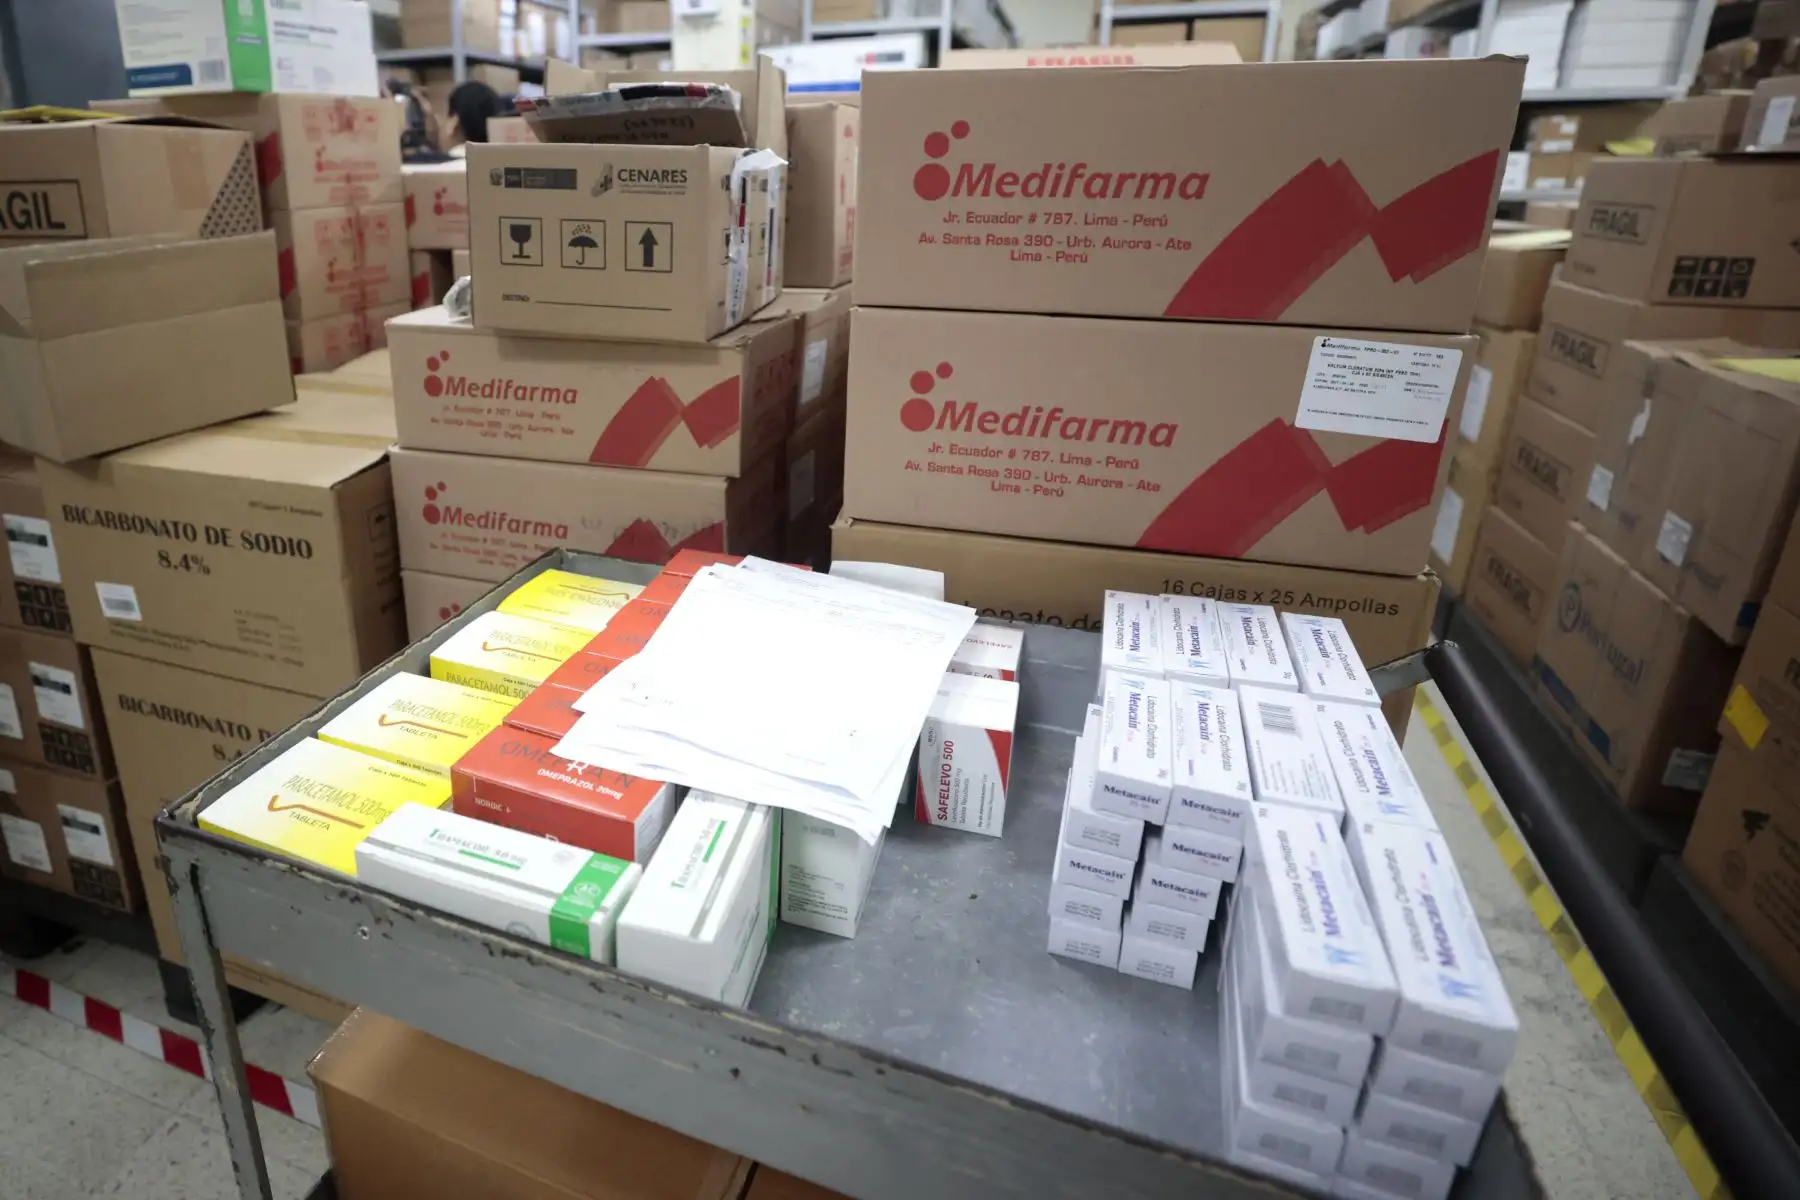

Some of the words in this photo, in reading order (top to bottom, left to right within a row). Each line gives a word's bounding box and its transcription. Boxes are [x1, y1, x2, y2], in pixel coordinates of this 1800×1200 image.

[617, 168, 688, 184] CENARES
[951, 162, 1211, 200] Medifarma
[942, 212, 961, 225] Jr.
[966, 212, 1023, 225] Ecuador
[1028, 213, 1037, 224] #
[1084, 213, 1119, 226] Lima
[1132, 214, 1168, 227] Perú
[918, 232, 938, 245] Av.
[942, 233, 981, 246] Santa
[985, 234, 1020, 247] Rosa
[1023, 235, 1053, 247] 390
[1066, 235, 1096, 248] Urb.
[1102, 236, 1152, 250] Aurora
[1165, 237, 1192, 250] Ate
[1010, 250, 1042, 262] Lima
[1055, 250, 1088, 264] Perú
[444, 375, 578, 404] Medifarma
[935, 400, 1179, 448] Medifarma
[927, 441, 944, 454] Jr.
[949, 443, 1004, 459] Ecuador
[1060, 452, 1093, 467] Lima
[1105, 455, 1140, 470] Perú
[904, 459, 923, 472] Av.
[927, 461, 964, 476] Santa
[967, 465, 1000, 479] Rosa
[1044, 471, 1072, 485] Urb.
[1077, 474, 1124, 490] Aurora
[1136, 479, 1161, 493] Ate
[990, 481, 1022, 495] Lima
[1033, 483, 1065, 498] Perú
[62, 504, 198, 543] BICARBONATO
[204, 525, 234, 548] DE
[241, 530, 313, 560] SODIO
[442, 506, 569, 540] Medifarma
[157, 549, 211, 576] 8.4%
[1161, 579, 1184, 595] 16
[1190, 581, 1247, 602] Cajas
[1252, 589, 1263, 603] x
[1269, 588, 1295, 606] 25
[1301, 593, 1400, 616] Ampollas
[1129, 621, 1141, 652] Metacain
[1188, 624, 1202, 657] Metacain
[1241, 616, 1256, 646] Metacain
[1311, 627, 1330, 659] Metacain
[446, 671, 511, 696] PARACETAMOL
[118, 694, 252, 743] BICARBONATO
[1128, 691, 1141, 729] Metacain
[1197, 701, 1211, 741] Metacain
[399, 725, 439, 741] TABLETA
[942, 740, 955, 762] 500
[282, 775, 358, 811] PARACETAMOL
[537, 768, 595, 792] OMEPRAZOL
[595, 784, 624, 801] 20mg
[936, 763, 953, 822] SAFELEVO
[1103, 784, 1160, 805] Metacain
[475, 797, 503, 812] NORDIC
[1181, 798, 1242, 818] Metacain
[289, 811, 331, 831] TABLETA
[1172, 842, 1232, 863] Metacain
[1070, 860, 1125, 880] Metacain
[1151, 878, 1209, 899] Metacain
[1309, 869, 1343, 937] Metacain
